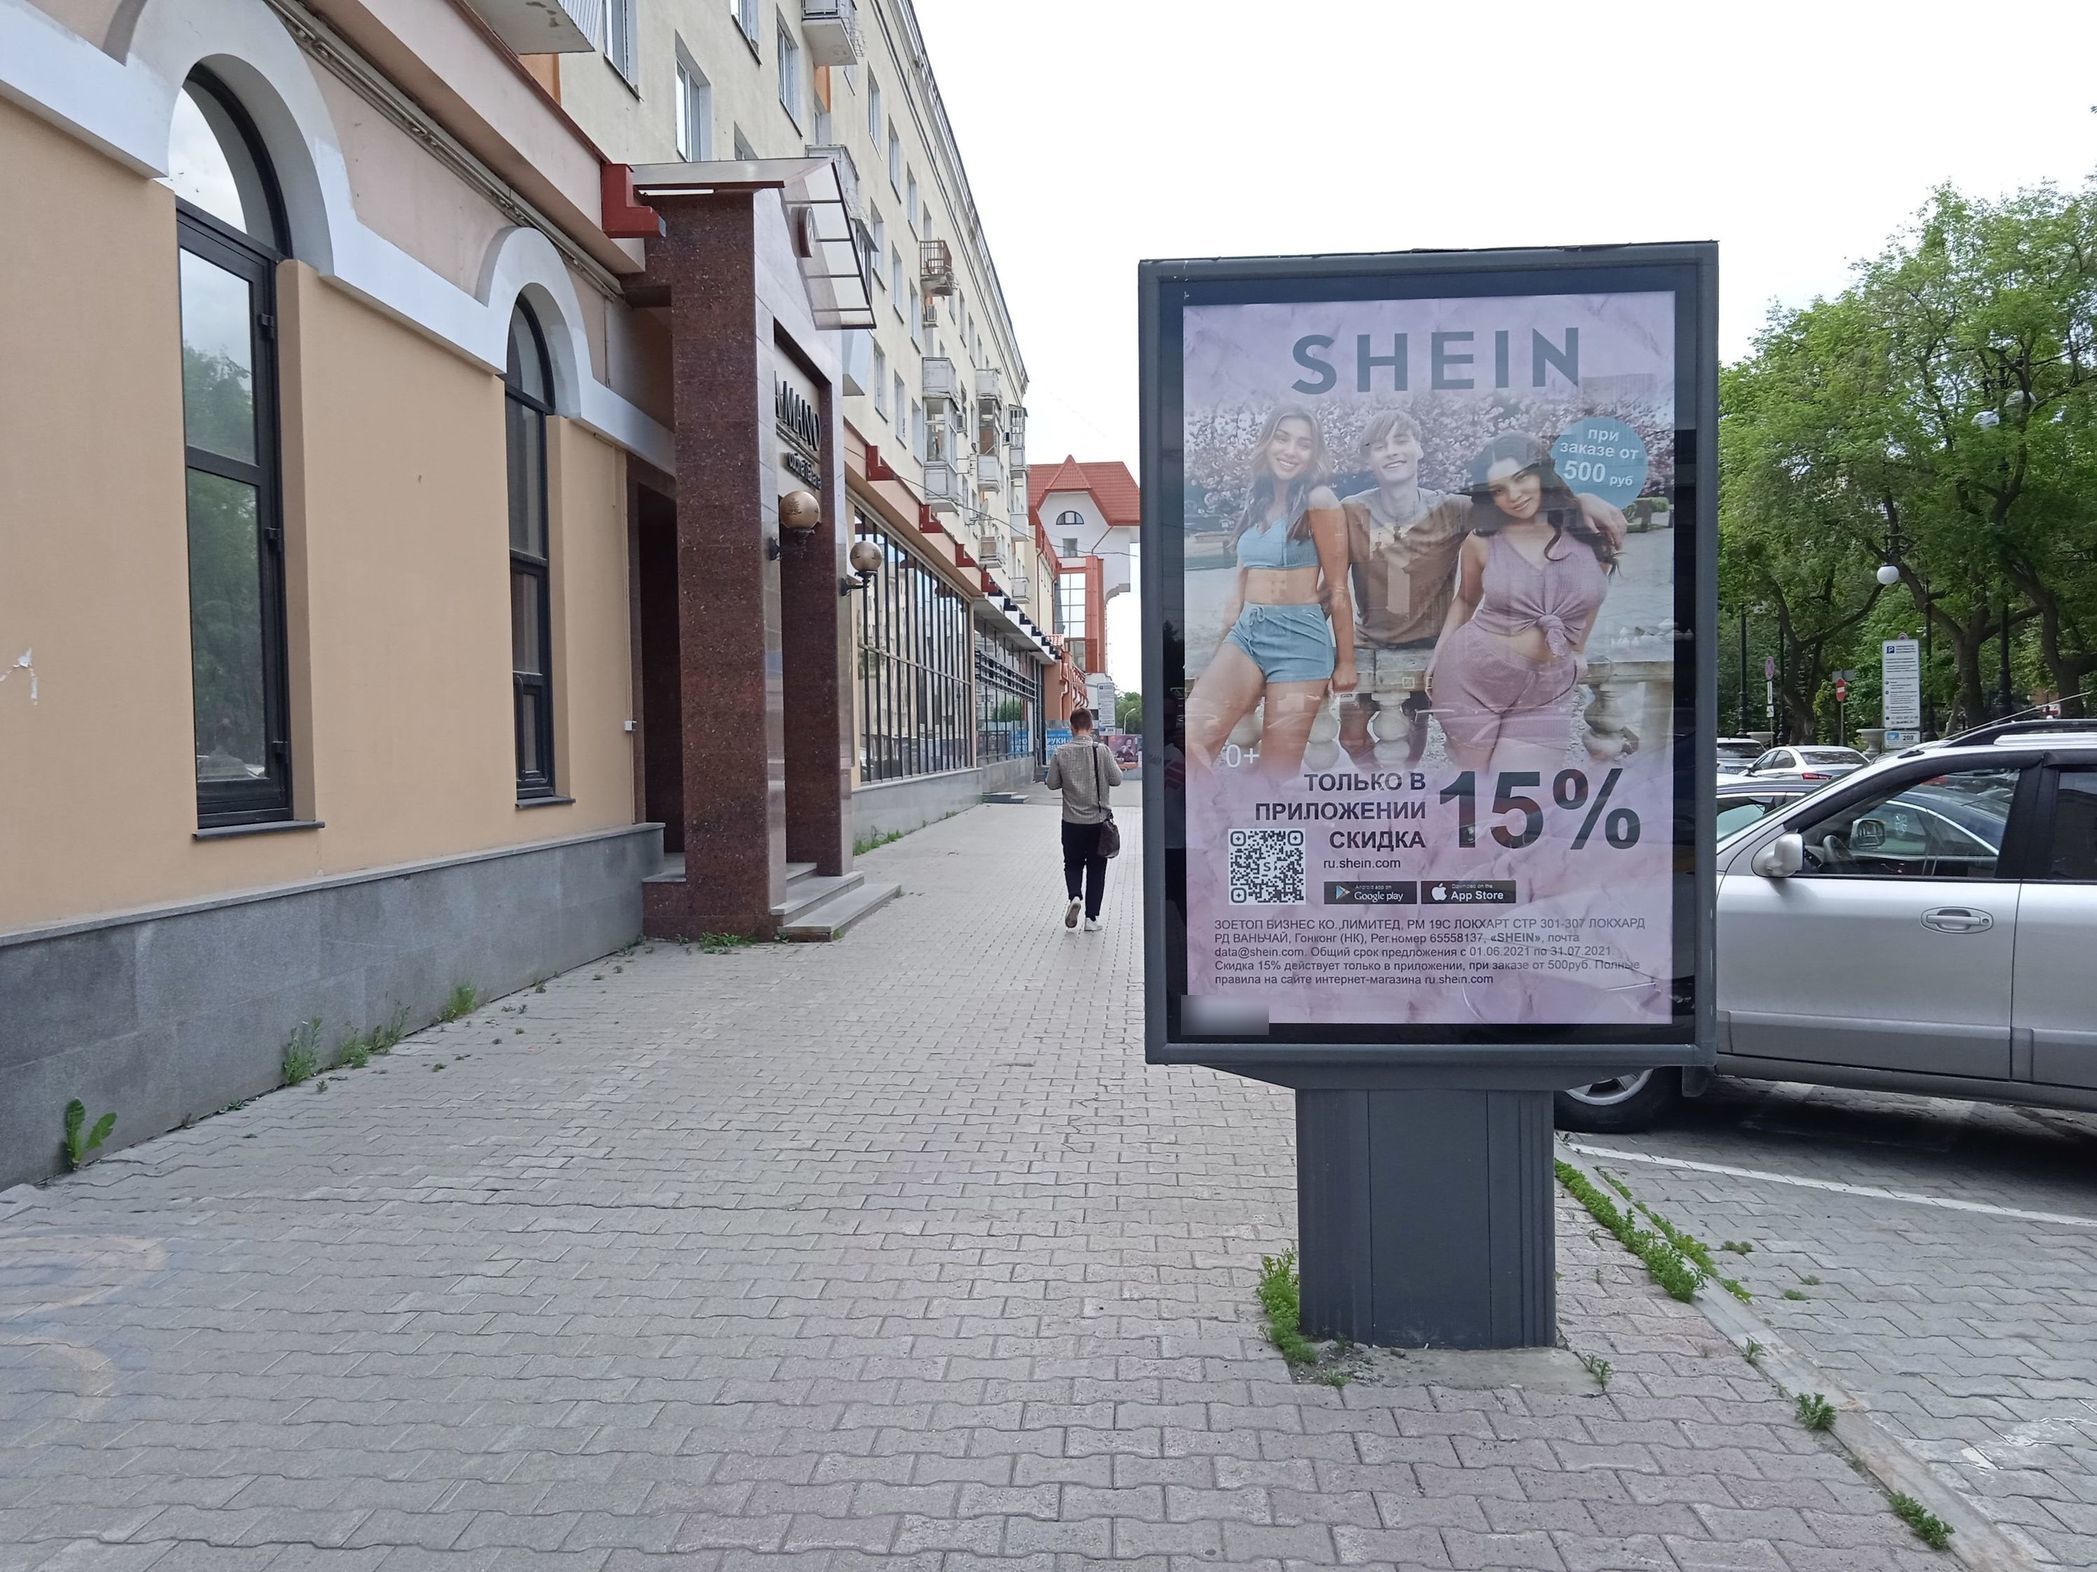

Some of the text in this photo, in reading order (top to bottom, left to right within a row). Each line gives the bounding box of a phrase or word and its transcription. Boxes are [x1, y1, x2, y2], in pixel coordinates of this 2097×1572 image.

[1291, 327, 1579, 395] SHEIN
[1587, 429, 1620, 443] при
[1560, 442, 1640, 460] заказе от
[1563, 460, 1633, 488] 500 руб
[1225, 744, 1260, 768] 0+
[1304, 772, 1426, 791] ТОЛЬКО В
[1255, 801, 1426, 821] ПРИЛОЖЕНИИ
[1439, 767, 1641, 850] 15%
[1329, 831, 1426, 852] СКИДКА
[1323, 858, 1401, 869] ru.shein.com
[1354, 890, 1404, 903] Google play
[1450, 890, 1504, 902] App Store
[1214, 919, 1263, 930] ЗОЕТОП
[1266, 919, 1315, 930] БИЗНЕС
[1454, 918, 1509, 930] ЛОКХАРТ
[1512, 918, 1537, 930] СТР
[1540, 918, 1585, 929] 301-307
[1588, 917, 1646, 930] ЛОКХАРД
[1214, 933, 1230, 944] РД
[1233, 931, 1292, 945] ВАНЬЧАЙ,
[1294, 933, 1337, 943] Гонконг
[1429, 932, 1487, 944] 65558137,
[1547, 934, 1580, 943] почта
[1310, 946, 1350, 959] Общий
[1353, 948, 1379, 959] срок
[1381, 948, 1457, 959] предложения
[1460, 948, 1466, 957] с
[1469, 946, 1530, 957] 01.06.2021
[1533, 948, 1548, 956] по
[1214, 960, 1254, 971] Скидка
[1258, 960, 1281, 971] 15%
[1284, 960, 1340, 973] действует
[1343, 962, 1381, 971] только
[1384, 962, 1391, 971] в
[1394, 962, 1466, 973] приложении,
[1468, 961, 1489, 972] при
[1492, 961, 1529, 970] заказе
[1532, 961, 1544, 970] от
[1594, 959, 1640, 970] Полные
[1215, 974, 1494, 986] правила на сайте интернет-магазина ru.shein.com
